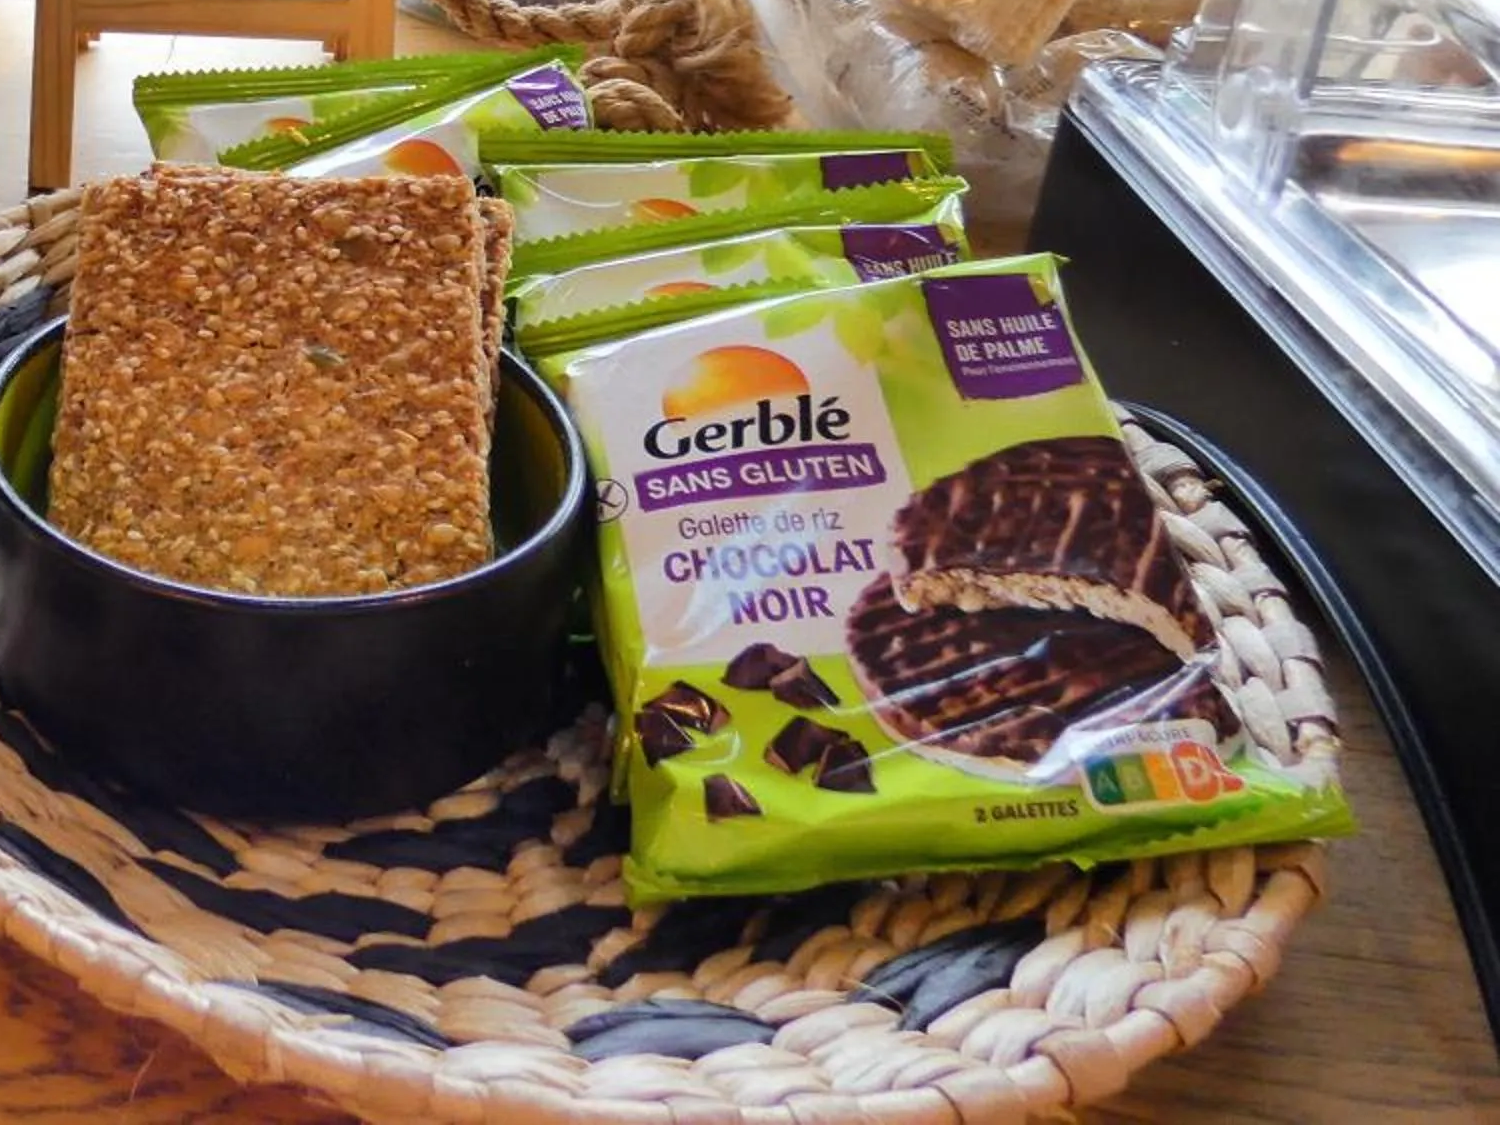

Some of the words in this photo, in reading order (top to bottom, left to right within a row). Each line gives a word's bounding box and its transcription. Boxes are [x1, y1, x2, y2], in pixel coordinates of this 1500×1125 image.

[947, 318, 998, 338] SANS
[1000, 312, 1057, 333] HUILE
[954, 345, 982, 362] DE
[984, 336, 1049, 359] PALME
[643, 394, 850, 459] Gerblé
[647, 466, 733, 500] SANS
[739, 454, 875, 485] GLUTEN
[678, 514, 767, 541] Galette
[772, 510, 805, 534] de
[811, 507, 844, 532] riz
[663, 539, 876, 583] CHOCOLAT
[726, 586, 835, 625] NOIR
[975, 808, 987, 823] 2
[991, 800, 1079, 821] GALETTES
